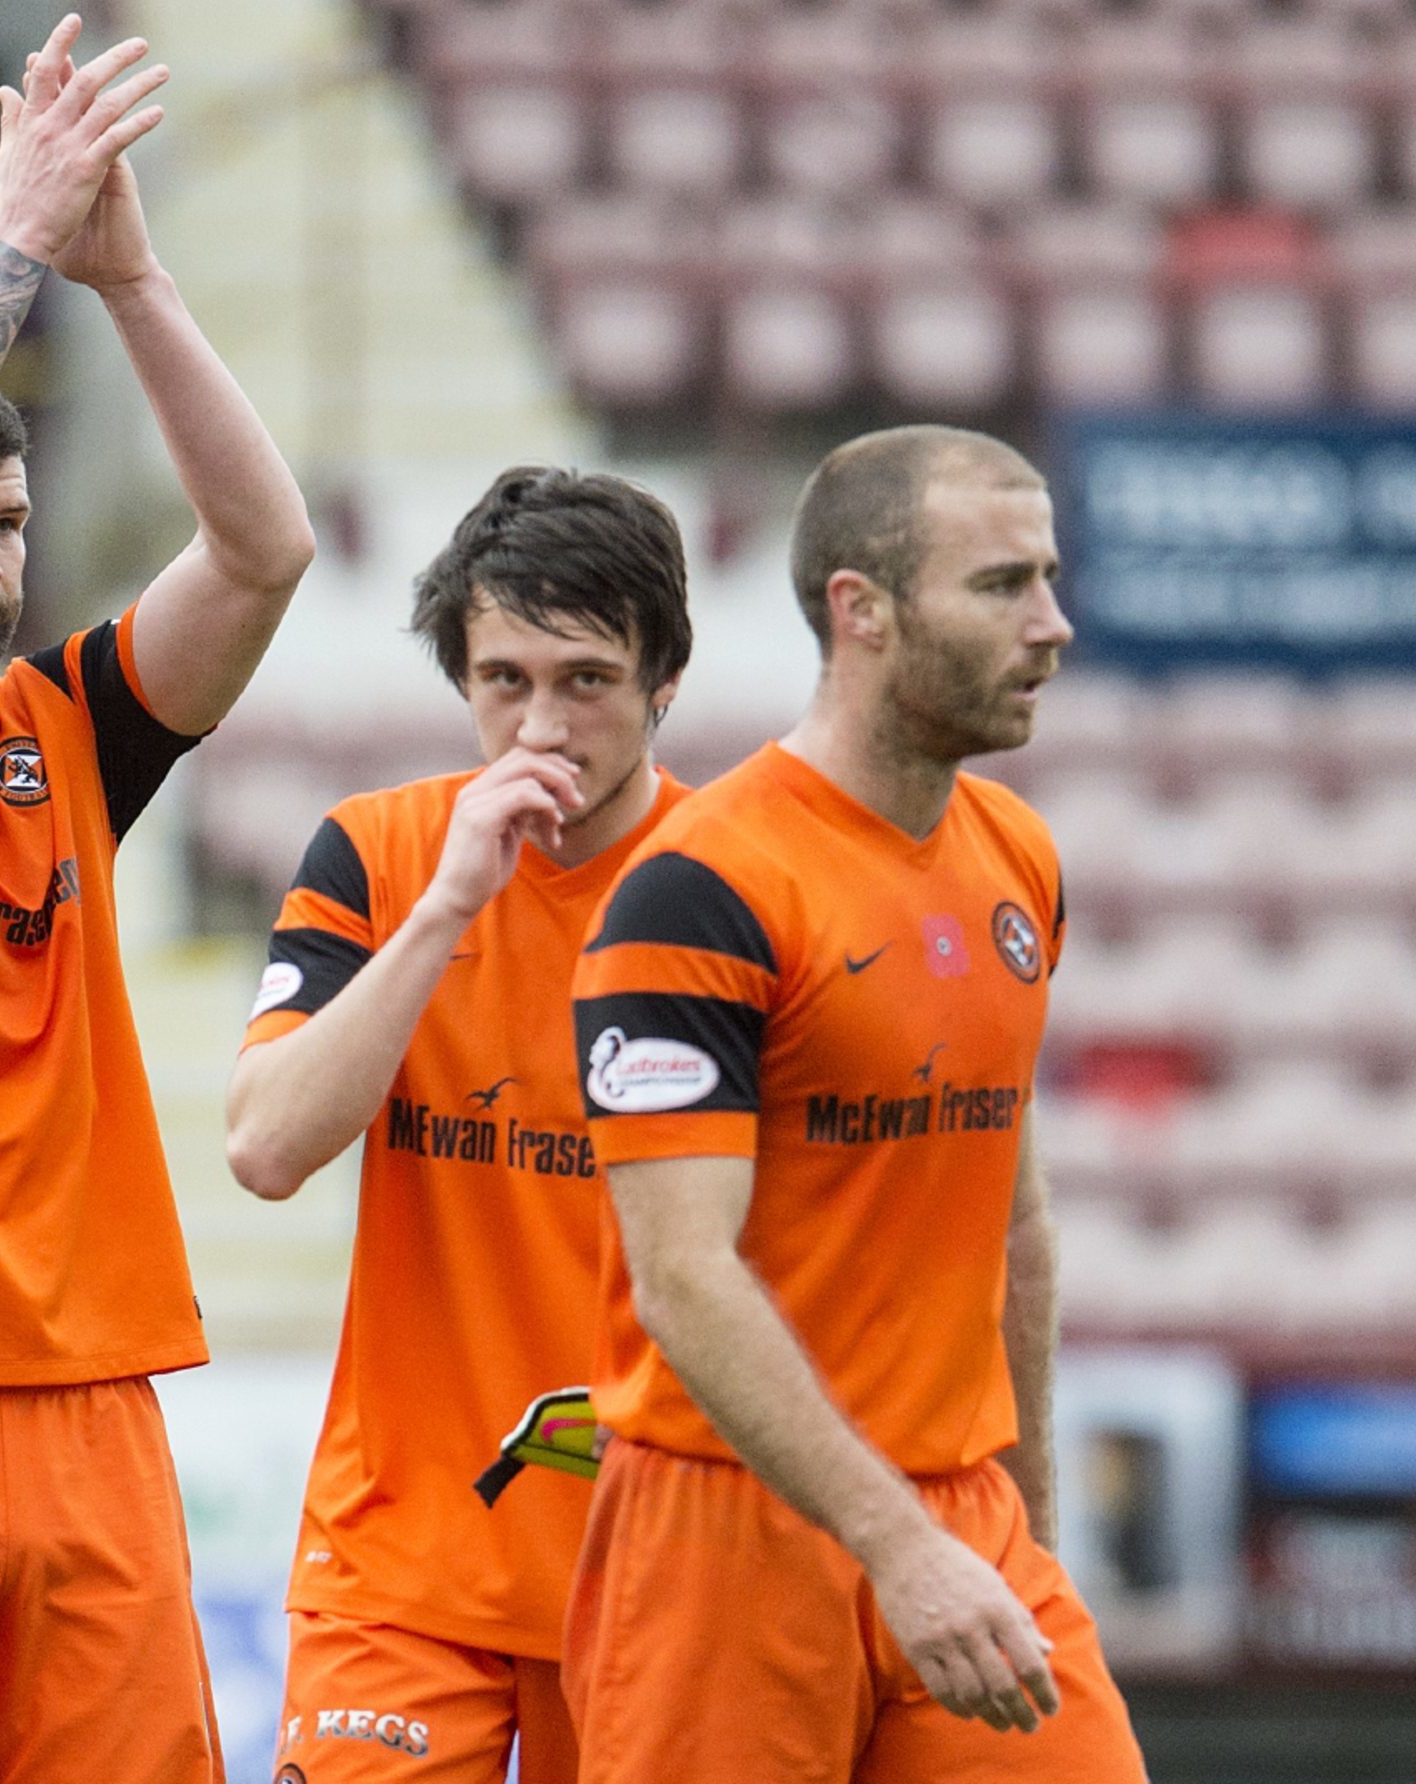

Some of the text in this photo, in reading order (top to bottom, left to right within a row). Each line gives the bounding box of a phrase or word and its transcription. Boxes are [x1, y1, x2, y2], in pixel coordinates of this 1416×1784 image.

[388, 1097, 597, 1178] MEwan Frase
[315, 1708, 431, 1759] KEGS
